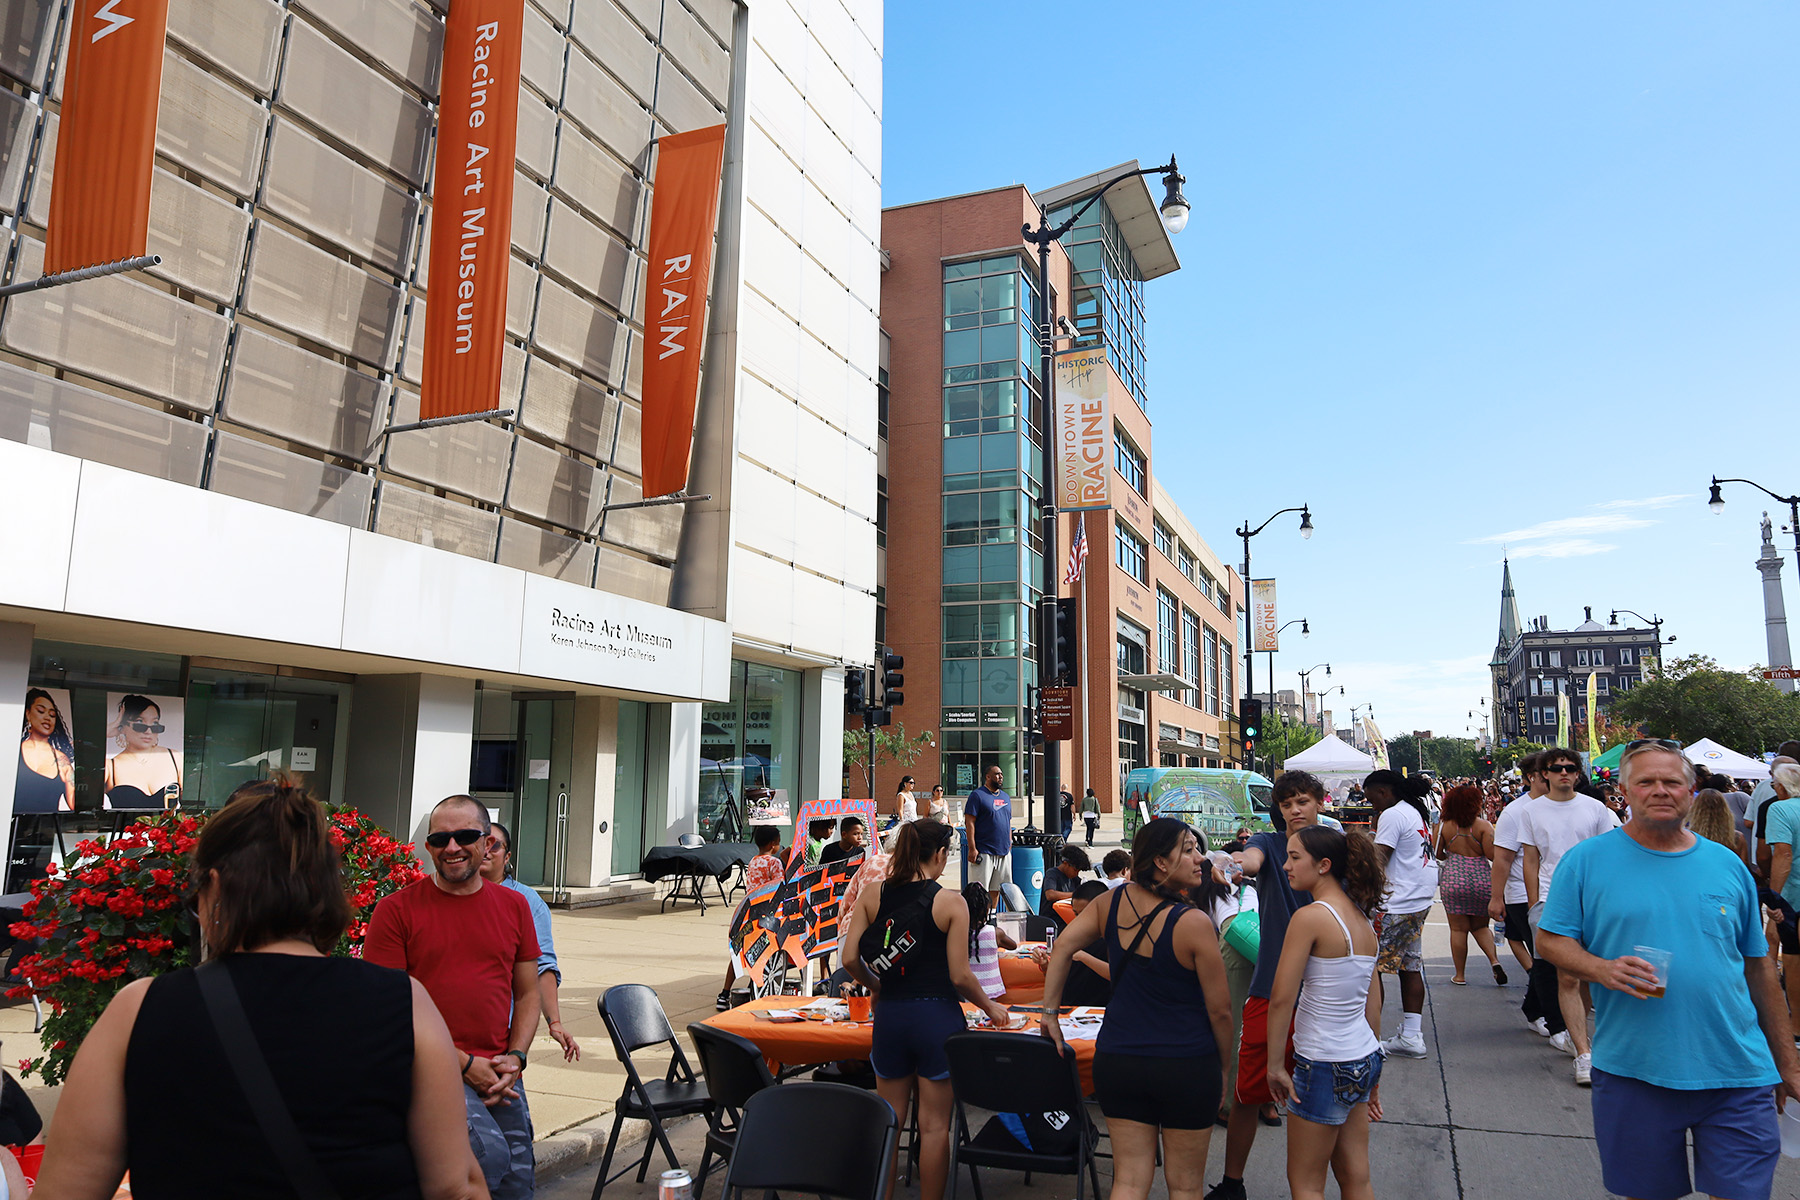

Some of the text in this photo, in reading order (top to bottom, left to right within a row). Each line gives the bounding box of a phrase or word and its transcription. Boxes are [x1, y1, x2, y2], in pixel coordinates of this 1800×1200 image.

[455, 20, 499, 355] Racine Art Museum
[1057, 355, 1104, 370] HISTORIC
[1066, 365, 1094, 388] Hip
[1063, 403, 1078, 504] DOWNTOWN
[1081, 400, 1106, 501] RACINE
[551, 607, 672, 649] Racine Art Museum
[1264, 603, 1276, 648] RACINE
[550, 633, 656, 662] Karen Johnson Boyd Galleries
[1518, 701, 1528, 740] DEWEY
